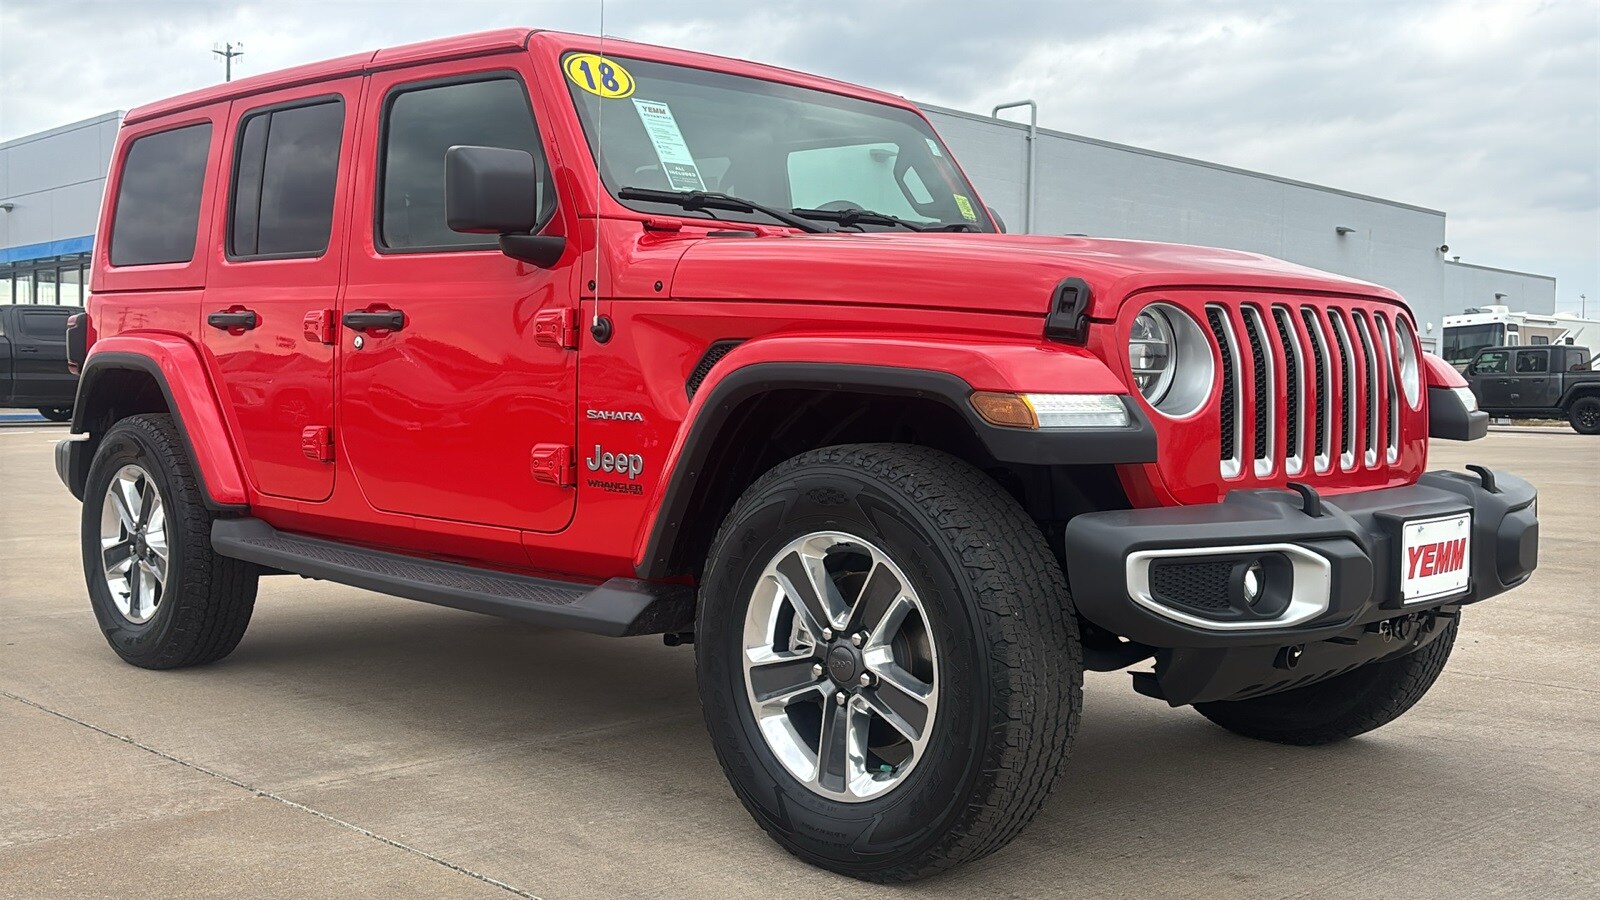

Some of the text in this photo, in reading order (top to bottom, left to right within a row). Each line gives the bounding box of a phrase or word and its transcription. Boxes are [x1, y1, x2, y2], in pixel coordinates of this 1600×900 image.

[579, 60, 620, 92] 18
[641, 105, 666, 114] YEMM
[586, 409, 643, 421] SAHARA
[586, 444, 643, 480] Jeep
[587, 479, 642, 491] WRANGLER
[1407, 537, 1467, 580] YEMM
